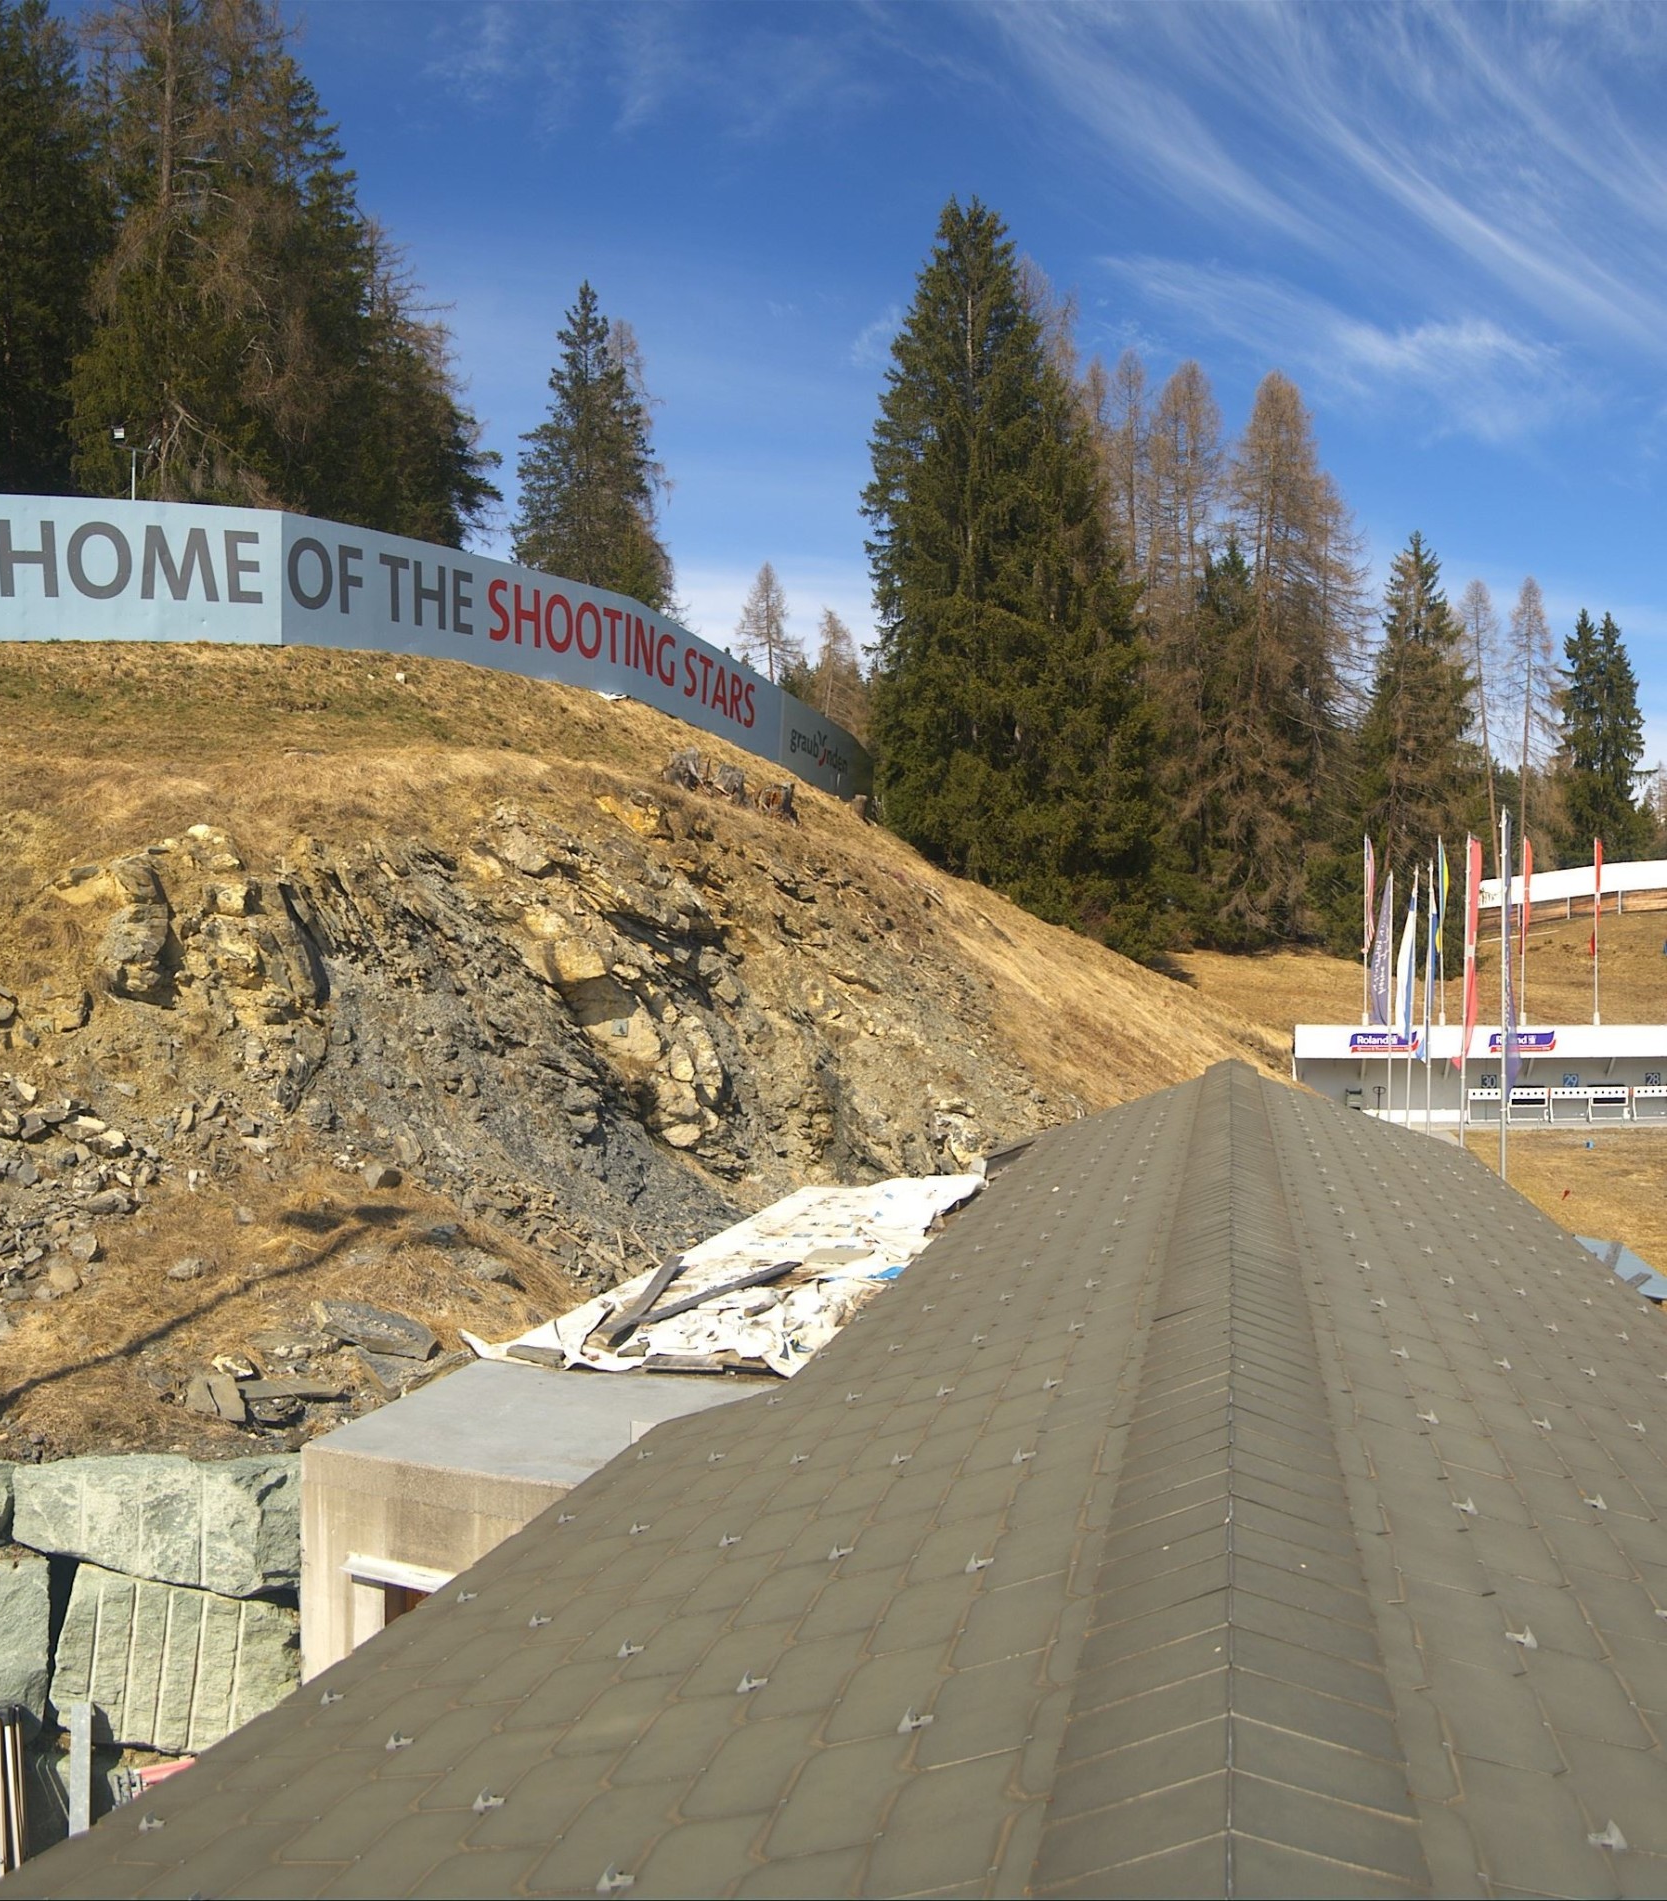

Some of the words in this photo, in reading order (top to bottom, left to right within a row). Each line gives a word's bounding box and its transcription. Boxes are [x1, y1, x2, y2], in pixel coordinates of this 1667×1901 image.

[287, 536, 363, 615] OF
[379, 553, 473, 635] THE
[489, 578, 676, 687] SHOOTING
[683, 647, 756, 729] STARS
[1357, 1035, 1389, 1044] Roland
[1496, 1035, 1527, 1044] Rnd
[1482, 1076, 1496, 1088] 30
[1564, 1075, 1578, 1086] 29
[1647, 1073, 1660, 1085] 28
